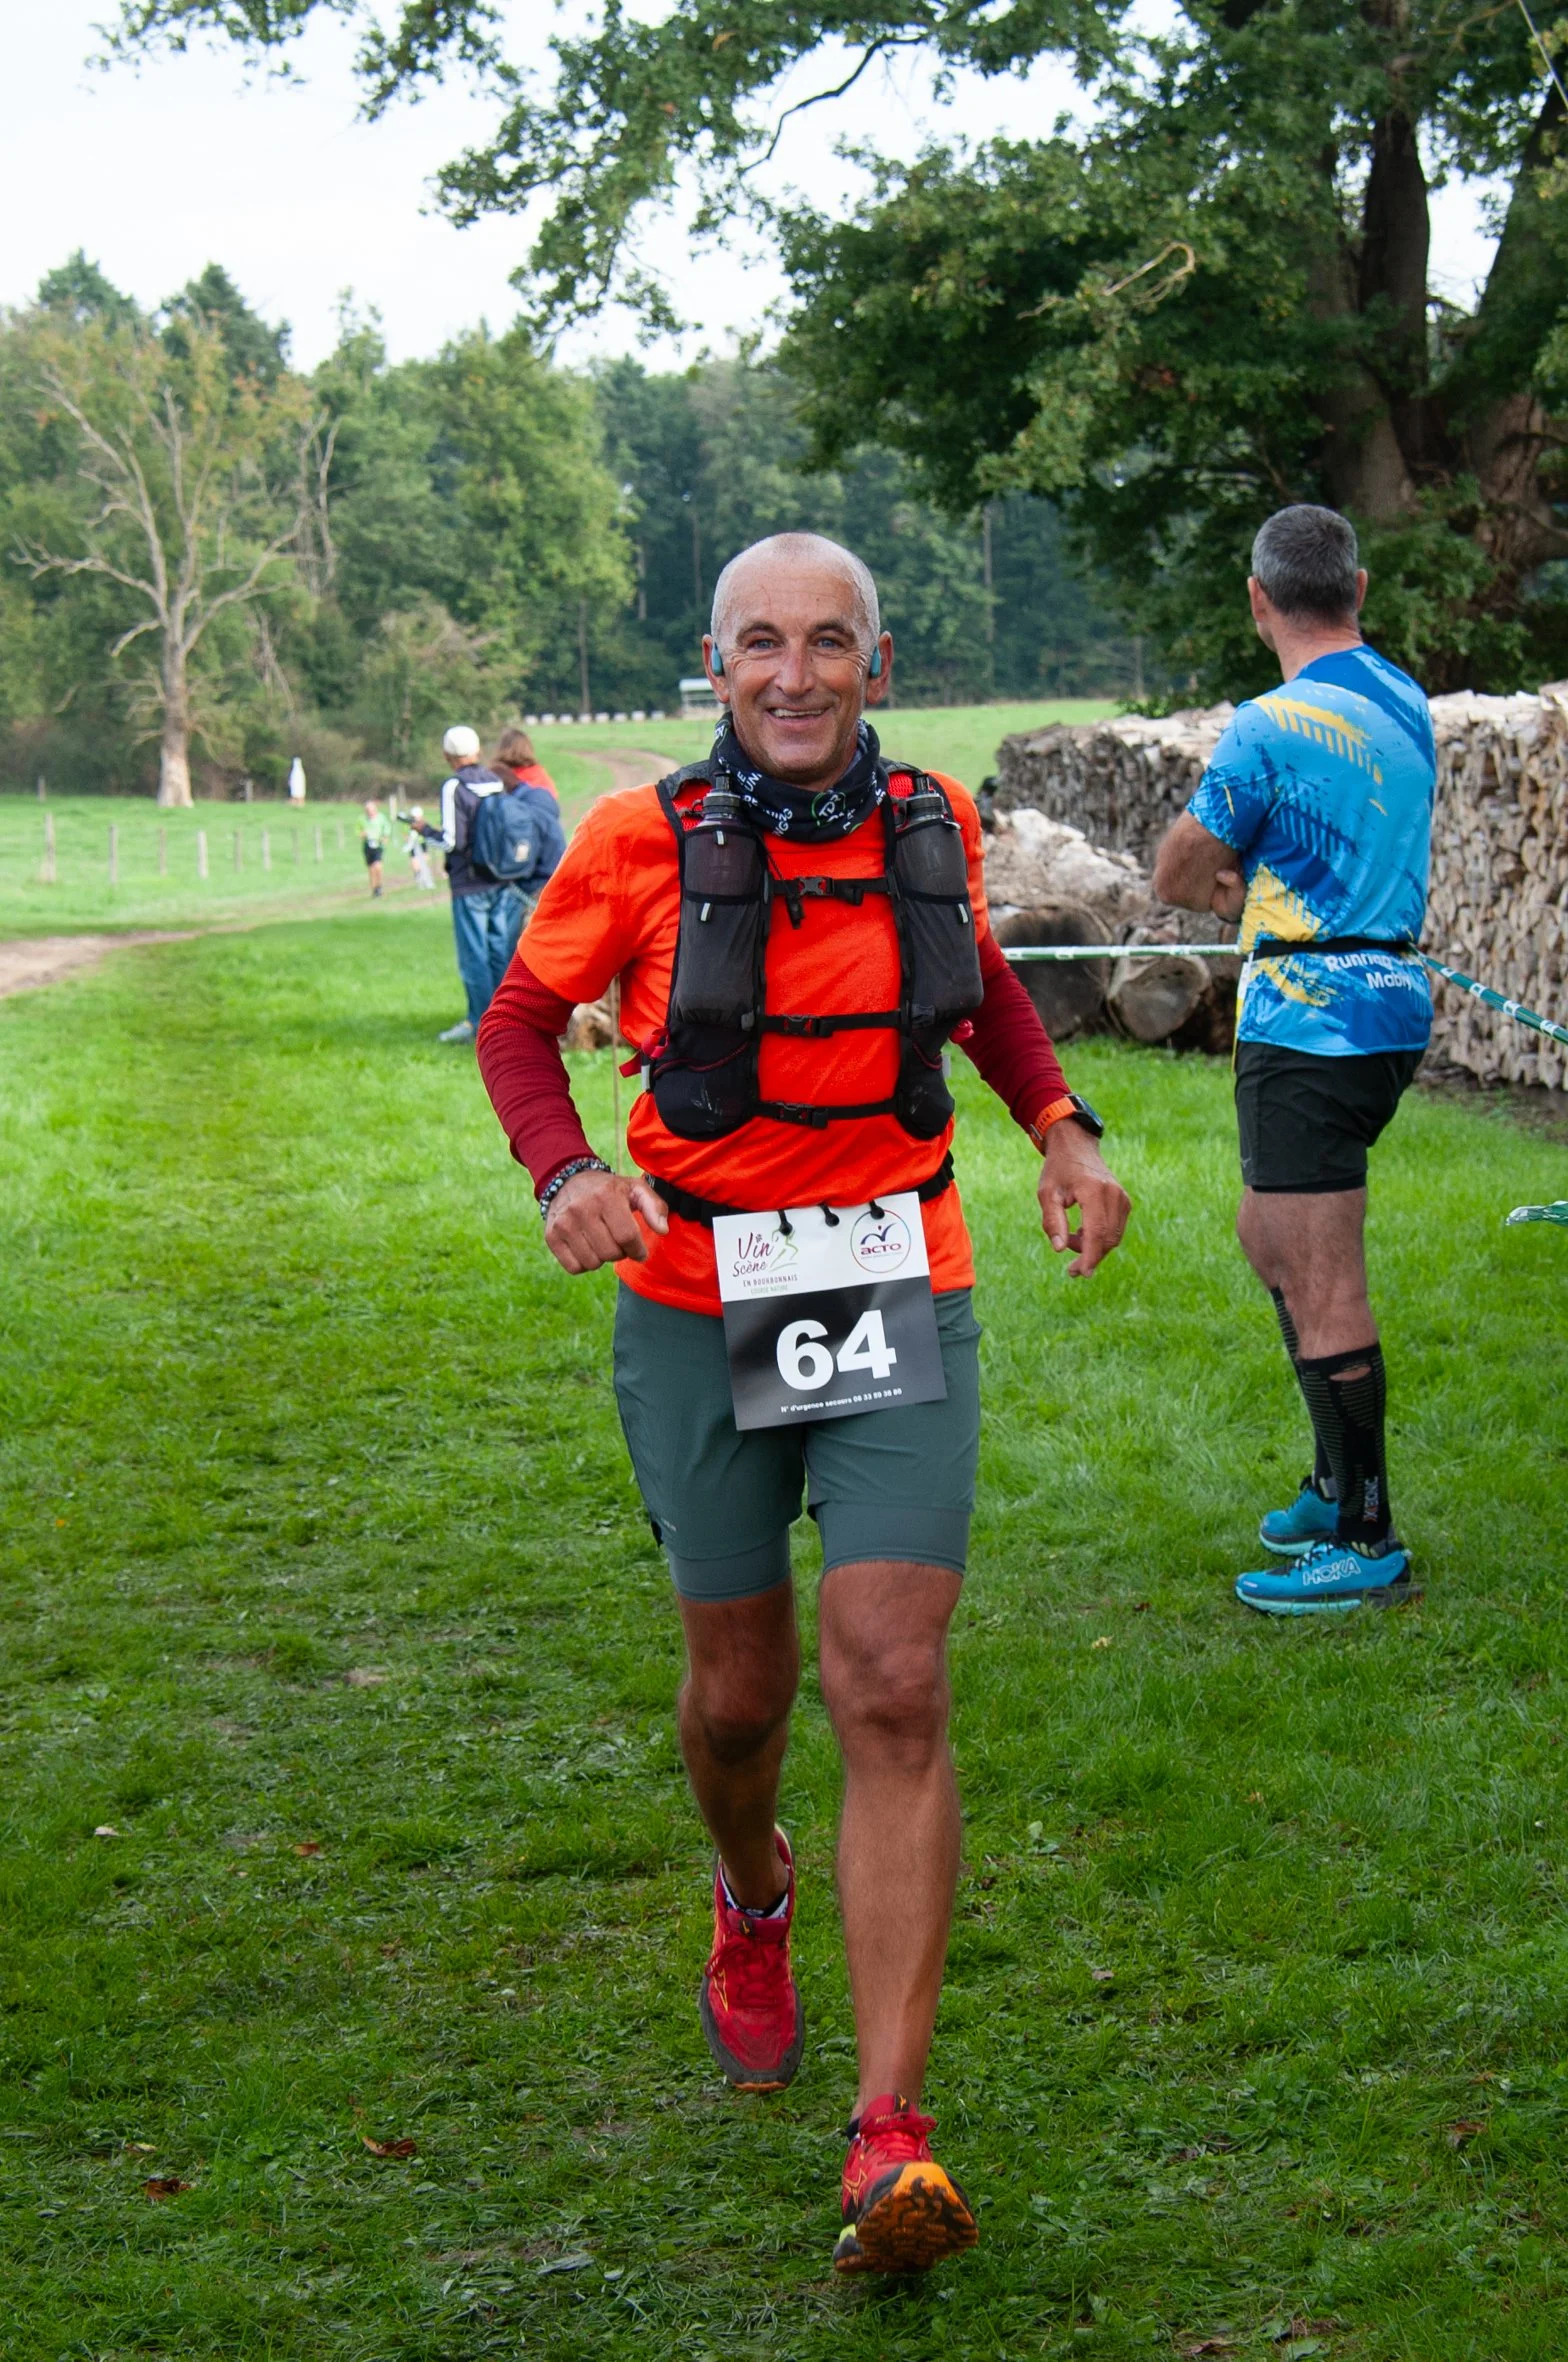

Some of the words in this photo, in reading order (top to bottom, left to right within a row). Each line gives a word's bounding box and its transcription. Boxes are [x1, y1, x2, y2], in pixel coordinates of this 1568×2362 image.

[738, 1232, 773, 1260] Vin
[732, 1260, 768, 1278] Scène
[743, 1279, 752, 1287] EN
[753, 1274, 798, 1286] BOURBONNAIS
[776, 1309, 898, 1391] 64
[1302, 1556, 1361, 1586] HOKA
